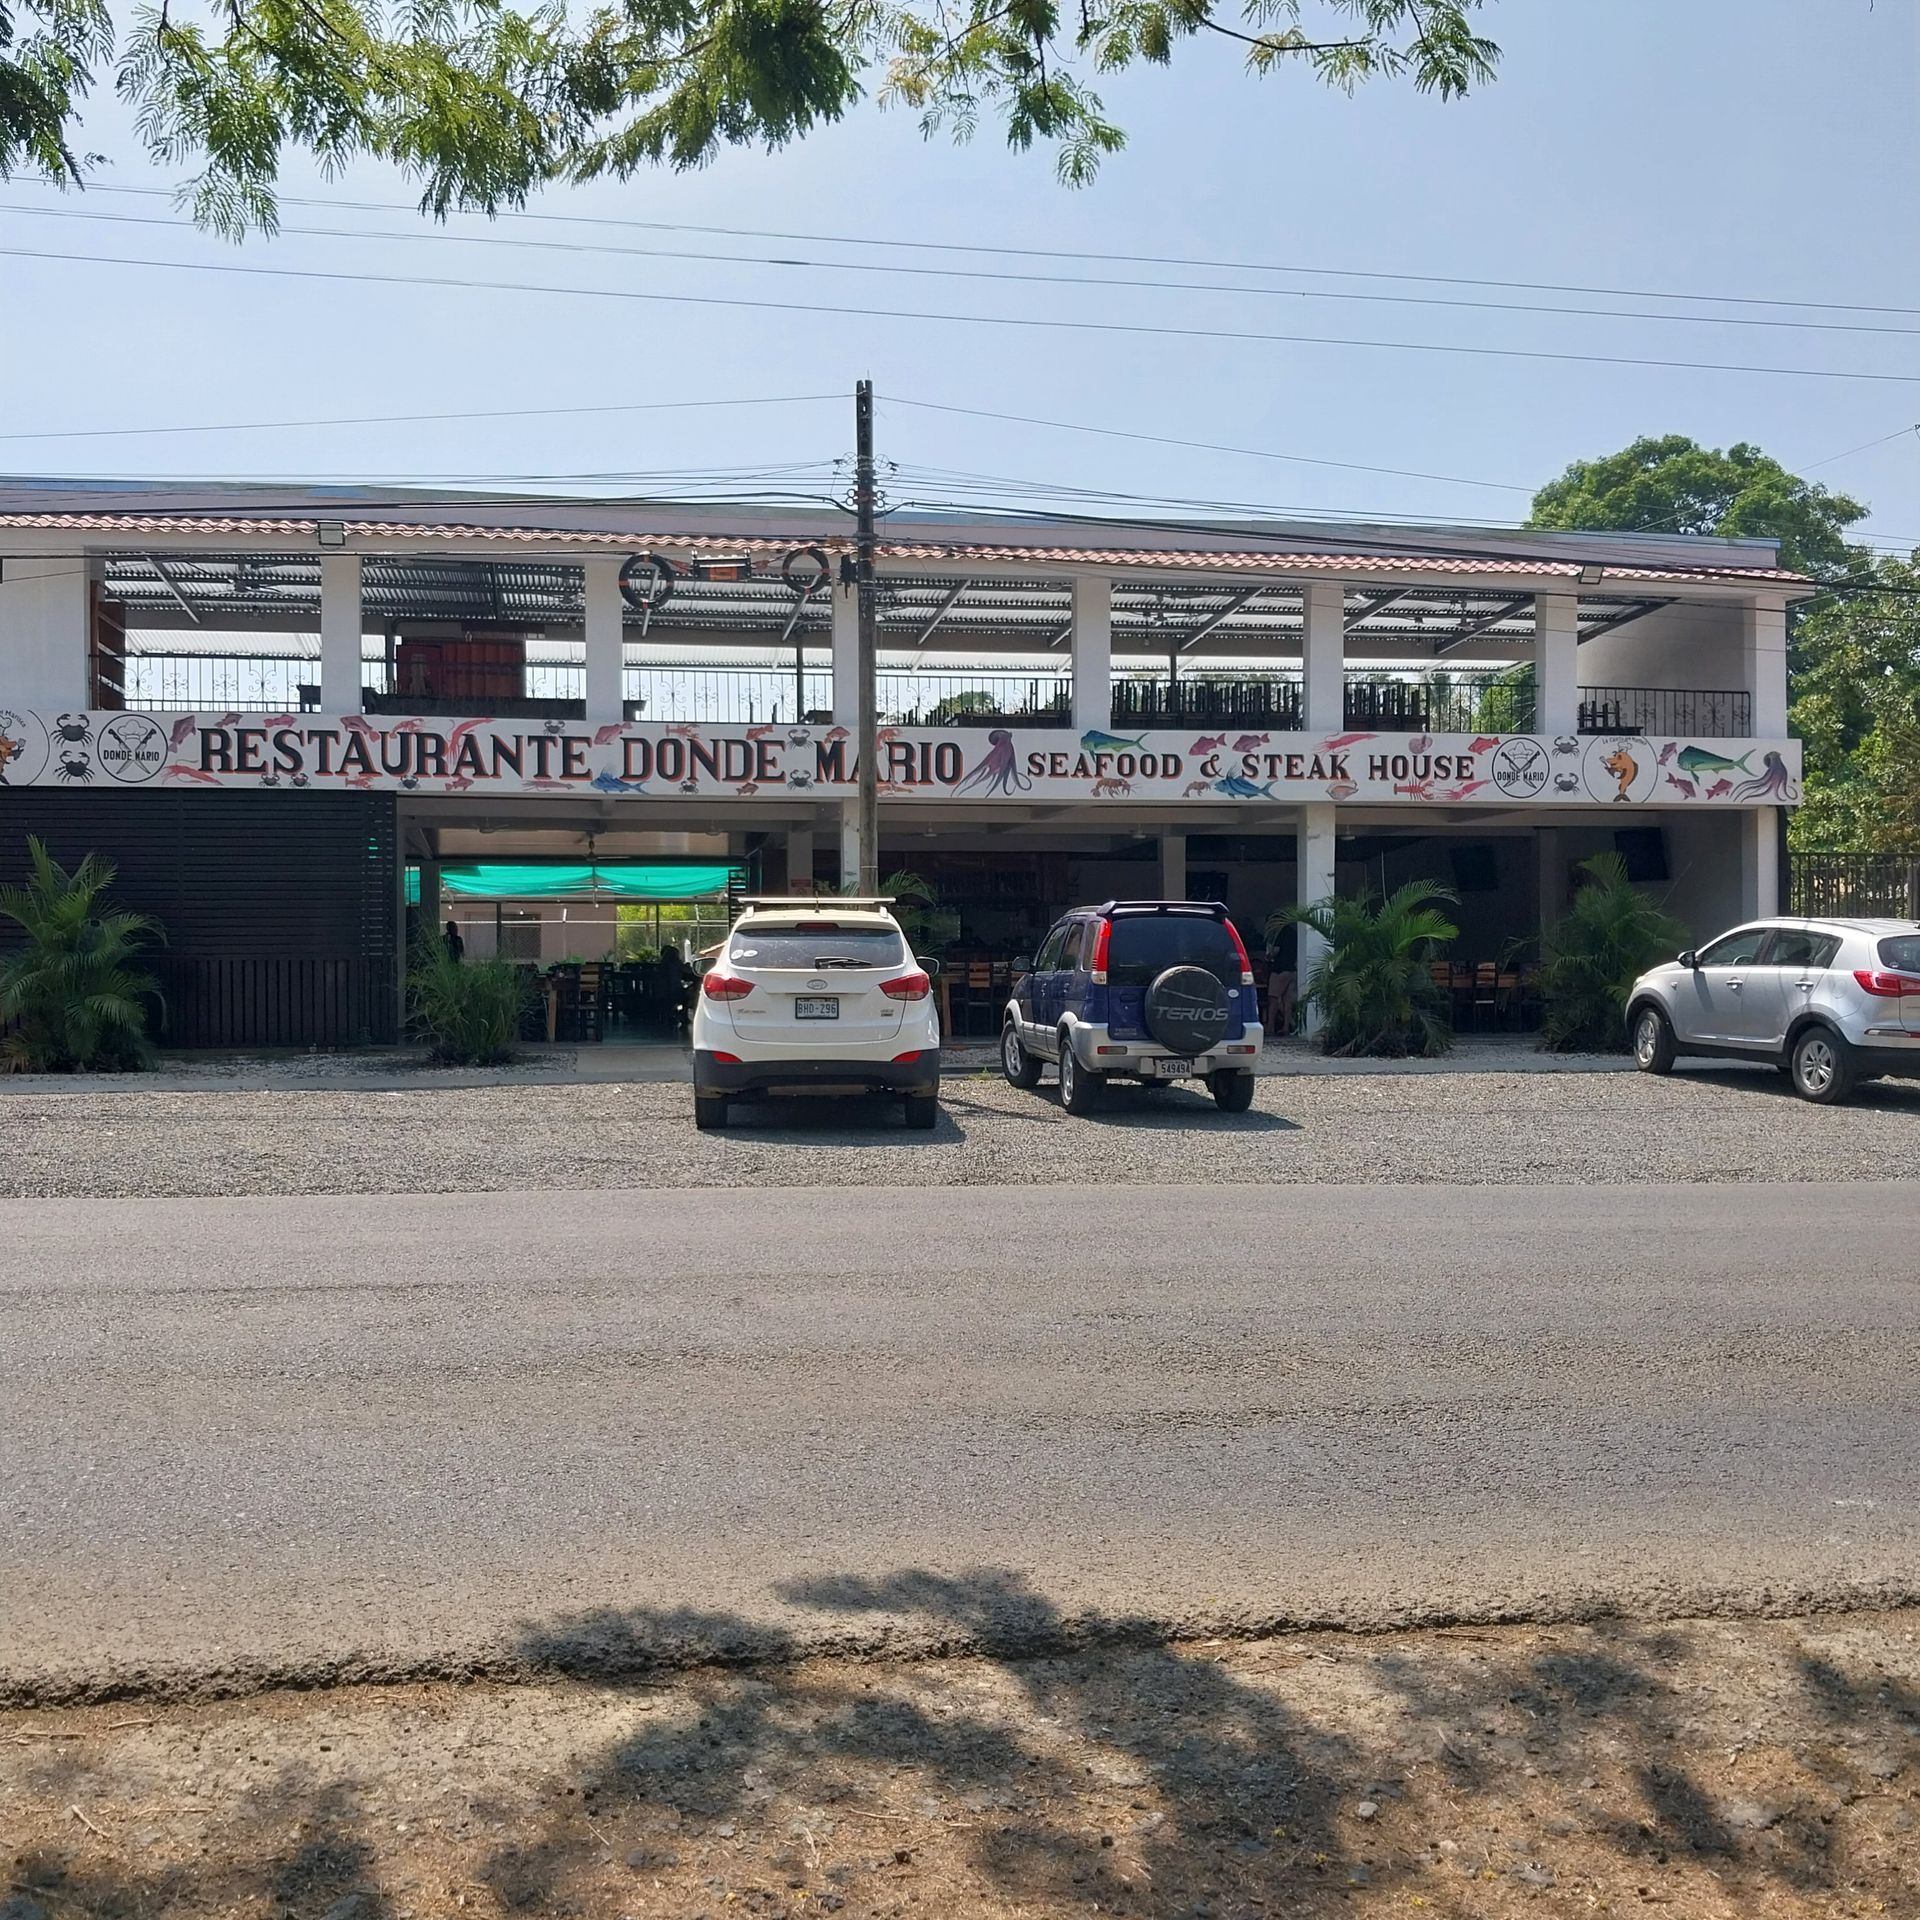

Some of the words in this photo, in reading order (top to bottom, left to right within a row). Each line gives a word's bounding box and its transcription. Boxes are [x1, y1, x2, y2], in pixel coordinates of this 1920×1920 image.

[103, 750, 132, 761] DONDE
[135, 751, 160, 762] MARIO
[197, 727, 593, 781] RESTAURANTE
[620, 736, 787, 783] DONDE
[1027, 752, 1184, 780] SEAFOOD
[1199, 753, 1225, 778] &
[1240, 753, 1352, 781] STEAK
[1368, 755, 1476, 782] HOUSE
[1497, 771, 1520, 781] DONDE
[1523, 772, 1545, 782] MARIO
[798, 1003, 837, 1014] BHD-296
[1152, 1006, 1229, 1021] TERIOS
[1161, 1063, 1190, 1074] 549494
